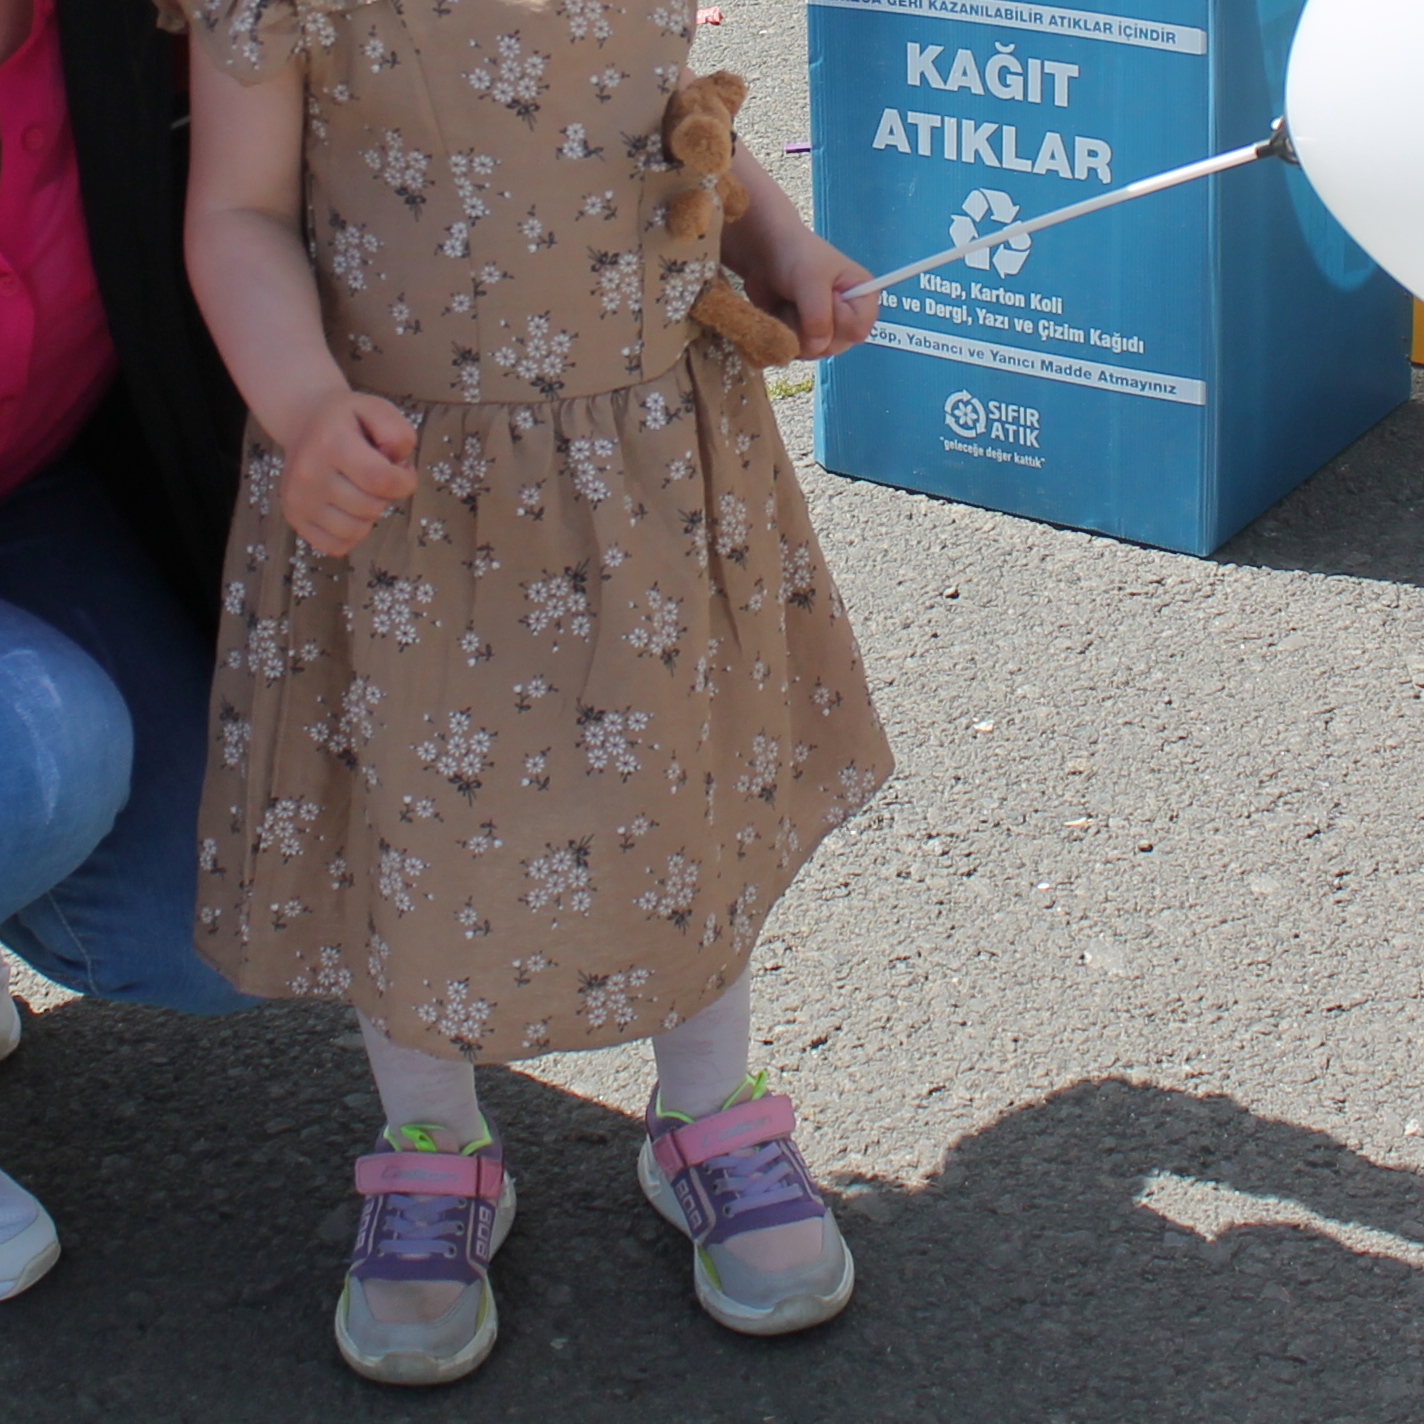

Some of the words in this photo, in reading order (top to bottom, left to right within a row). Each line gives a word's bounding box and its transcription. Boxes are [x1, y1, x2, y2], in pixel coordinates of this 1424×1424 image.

[1048, 12, 1114, 36] ATIKLAR
[1117, 21, 1177, 45] İÇİNDİR
[906, 41, 1080, 108] KAĞIT
[872, 108, 1113, 184] ATIKLAR
[919, 273, 967, 301] Kitap,
[970, 282, 1026, 308] Karton
[1030, 291, 1064, 316] Koli
[902, 297, 921, 313] ve
[925, 296, 973, 326] Dergi,
[977, 306, 1010, 330] Yazı
[1014, 317, 1034, 335] ve
[1038, 319, 1086, 343] Çizim
[1089, 329, 1146, 355] Kağıdı
[868, 326, 903, 346] Çöp,
[906, 333, 964, 357] Yabancı
[967, 346, 986, 361] ve
[989, 349, 1036, 370] Yanıcı
[1040, 358, 1093, 382] Madde
[1097, 369, 1178, 396] Atmayınız
[988, 400, 1041, 428] SIFIR
[985, 446, 1012, 464] değer
[990, 424, 1041, 449] ATIK
